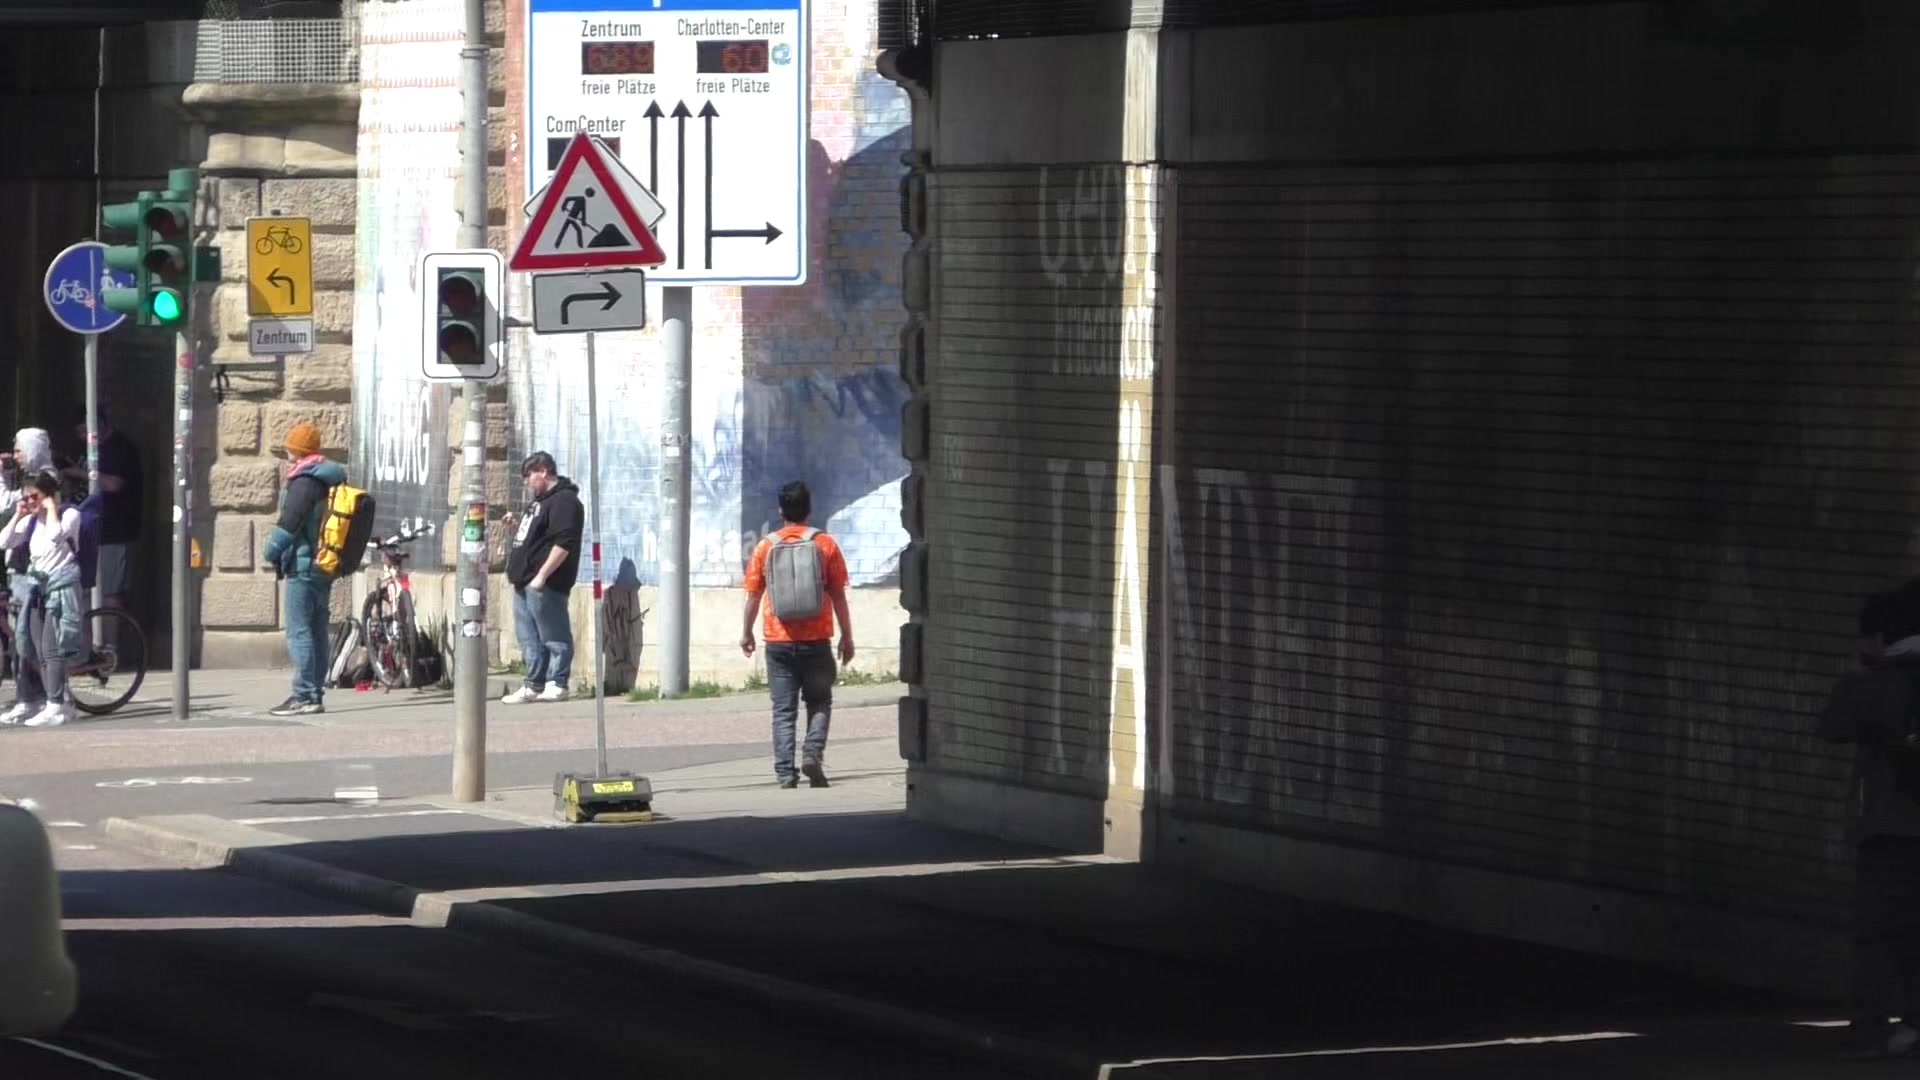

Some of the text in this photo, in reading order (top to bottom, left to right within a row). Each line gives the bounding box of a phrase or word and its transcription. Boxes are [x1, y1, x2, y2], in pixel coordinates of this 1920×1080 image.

[581, 20, 642, 37] Zentrum
[677, 18, 785, 35] Charlotten-Center
[721, 43, 767, 71] 60
[581, 78, 656, 95] freie Plätze
[696, 77, 770, 94] freie Plätze
[547, 115, 626, 133] ComCenter
[256, 329, 307, 344] Zentrum
[375, 380, 431, 486] GEORG
